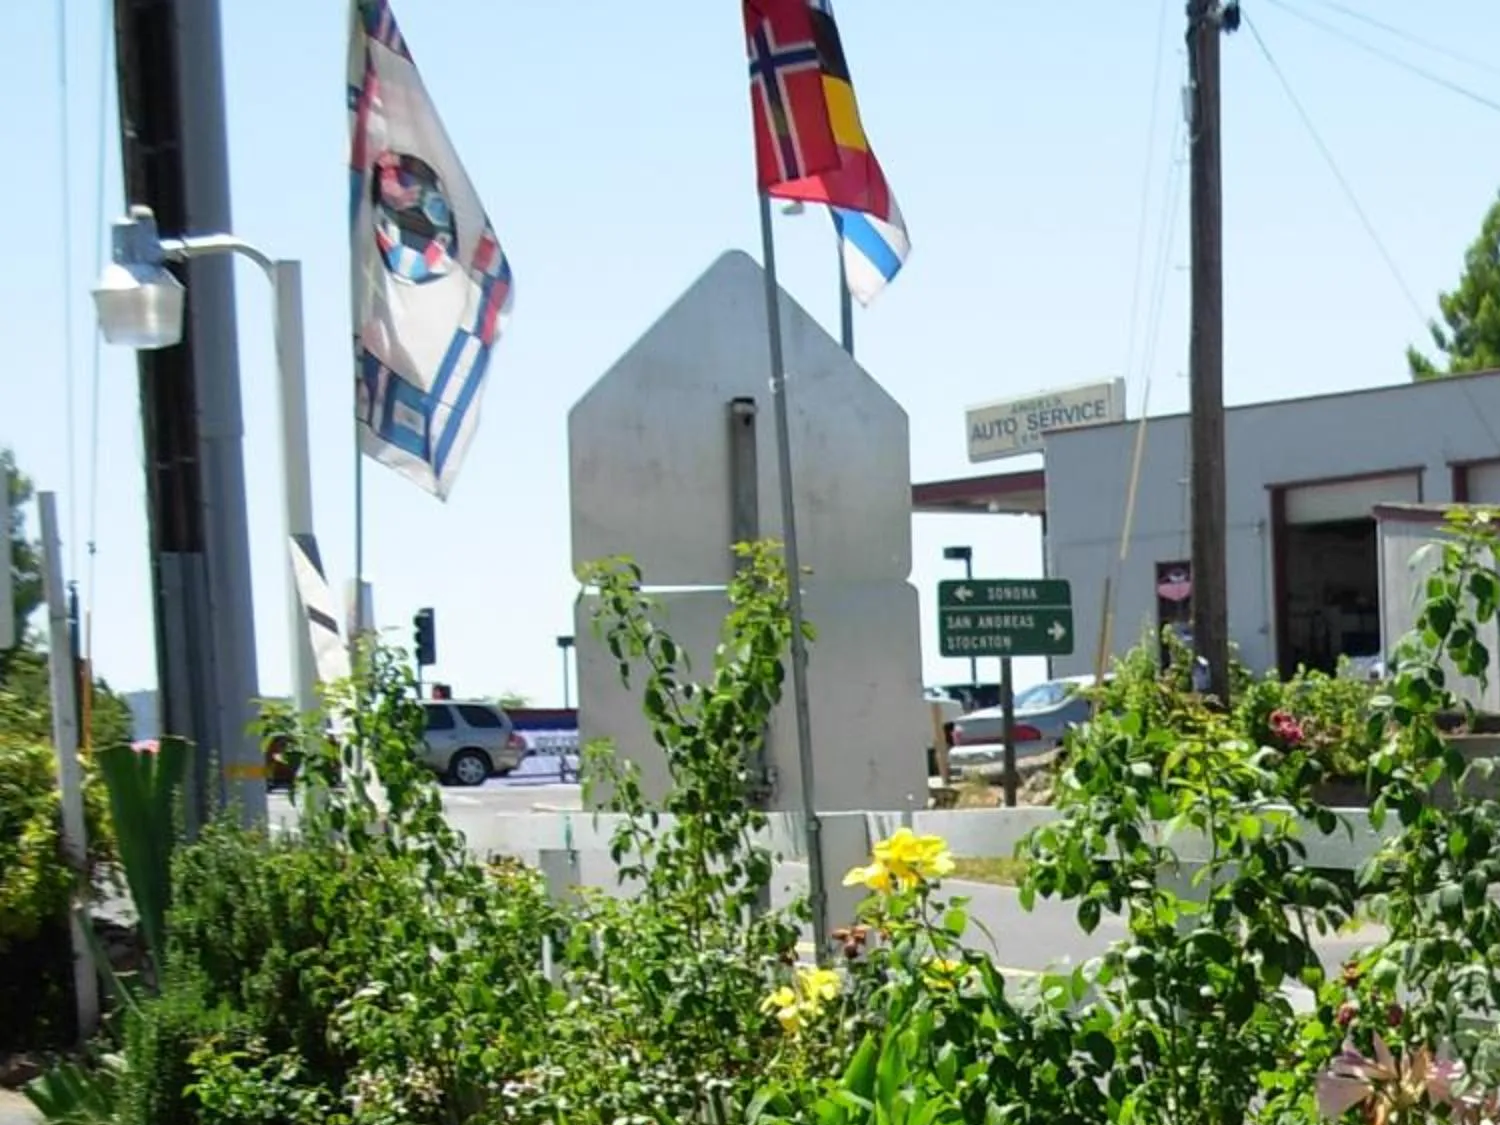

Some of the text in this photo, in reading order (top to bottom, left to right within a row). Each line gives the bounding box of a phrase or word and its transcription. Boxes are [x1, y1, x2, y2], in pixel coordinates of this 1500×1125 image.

[971, 418, 1018, 442] AUTO
[1027, 400, 1106, 431] SERVICE
[947, 615, 1034, 629] SAN ANDREAS
